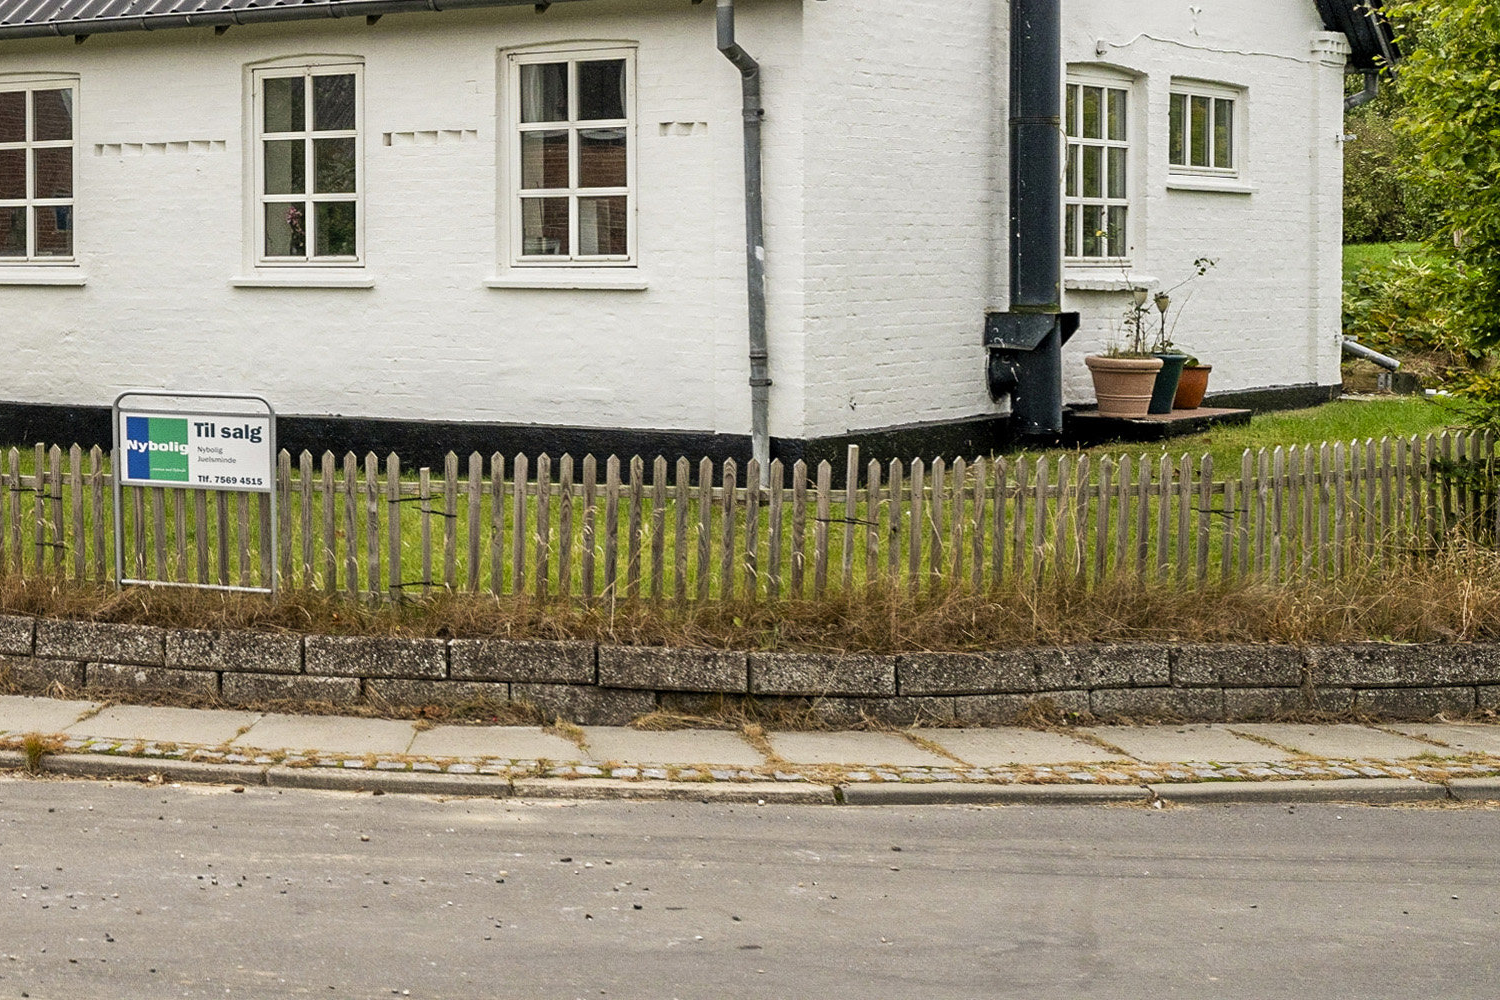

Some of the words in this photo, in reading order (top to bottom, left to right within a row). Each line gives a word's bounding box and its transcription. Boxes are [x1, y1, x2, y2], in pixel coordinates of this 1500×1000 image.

[193, 422, 215, 438] Til
[220, 424, 263, 444] salg
[127, 439, 189, 456] Nybolig
[197, 446, 223, 455] Nybolig
[197, 456, 237, 464] Juelsminde
[198, 475, 213, 483] Tlf.
[214, 476, 238, 484] 7569
[239, 477, 263, 486] 4515
